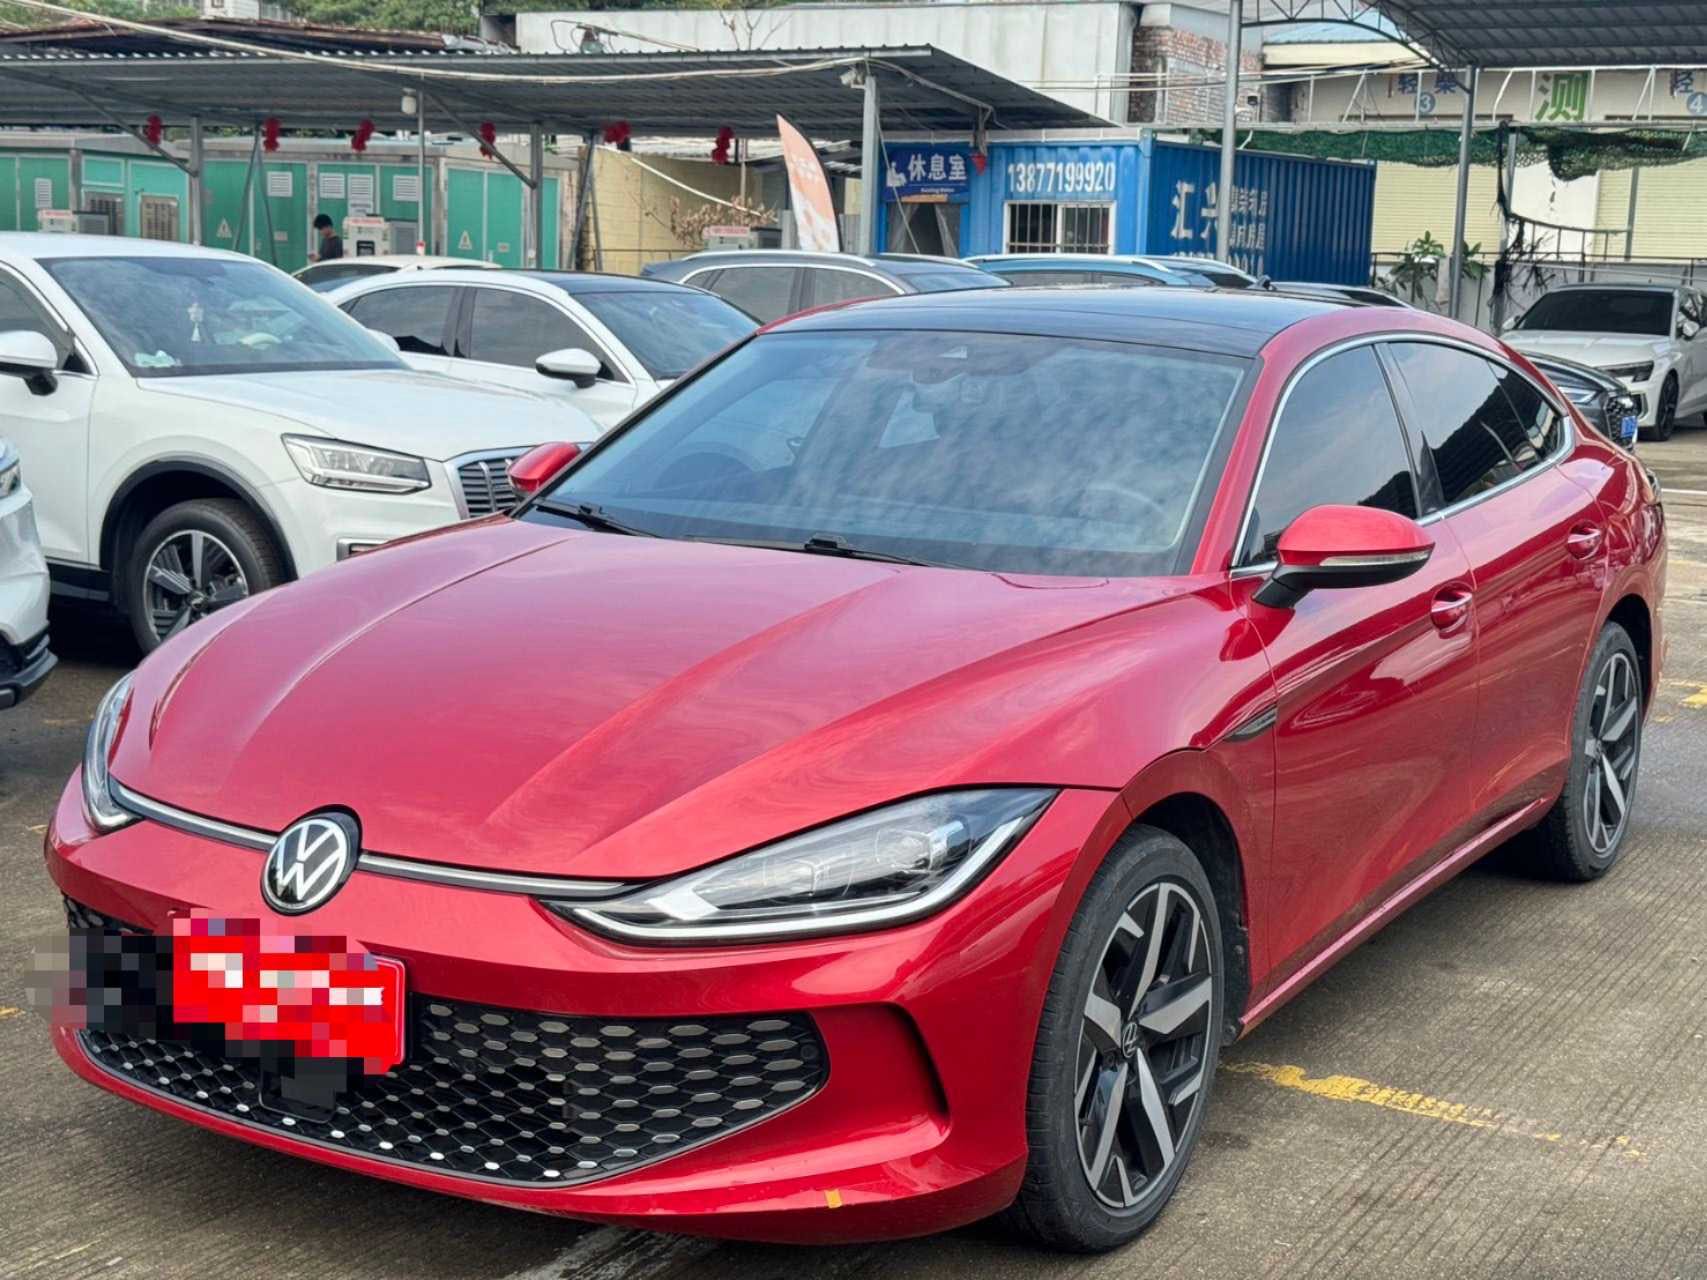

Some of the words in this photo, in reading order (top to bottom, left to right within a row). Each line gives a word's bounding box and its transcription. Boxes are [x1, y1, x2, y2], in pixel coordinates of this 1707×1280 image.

[1535, 71, 1587, 121] 测
[907, 153, 967, 181] 休息室
[1007, 161, 1116, 192] 13877199920
